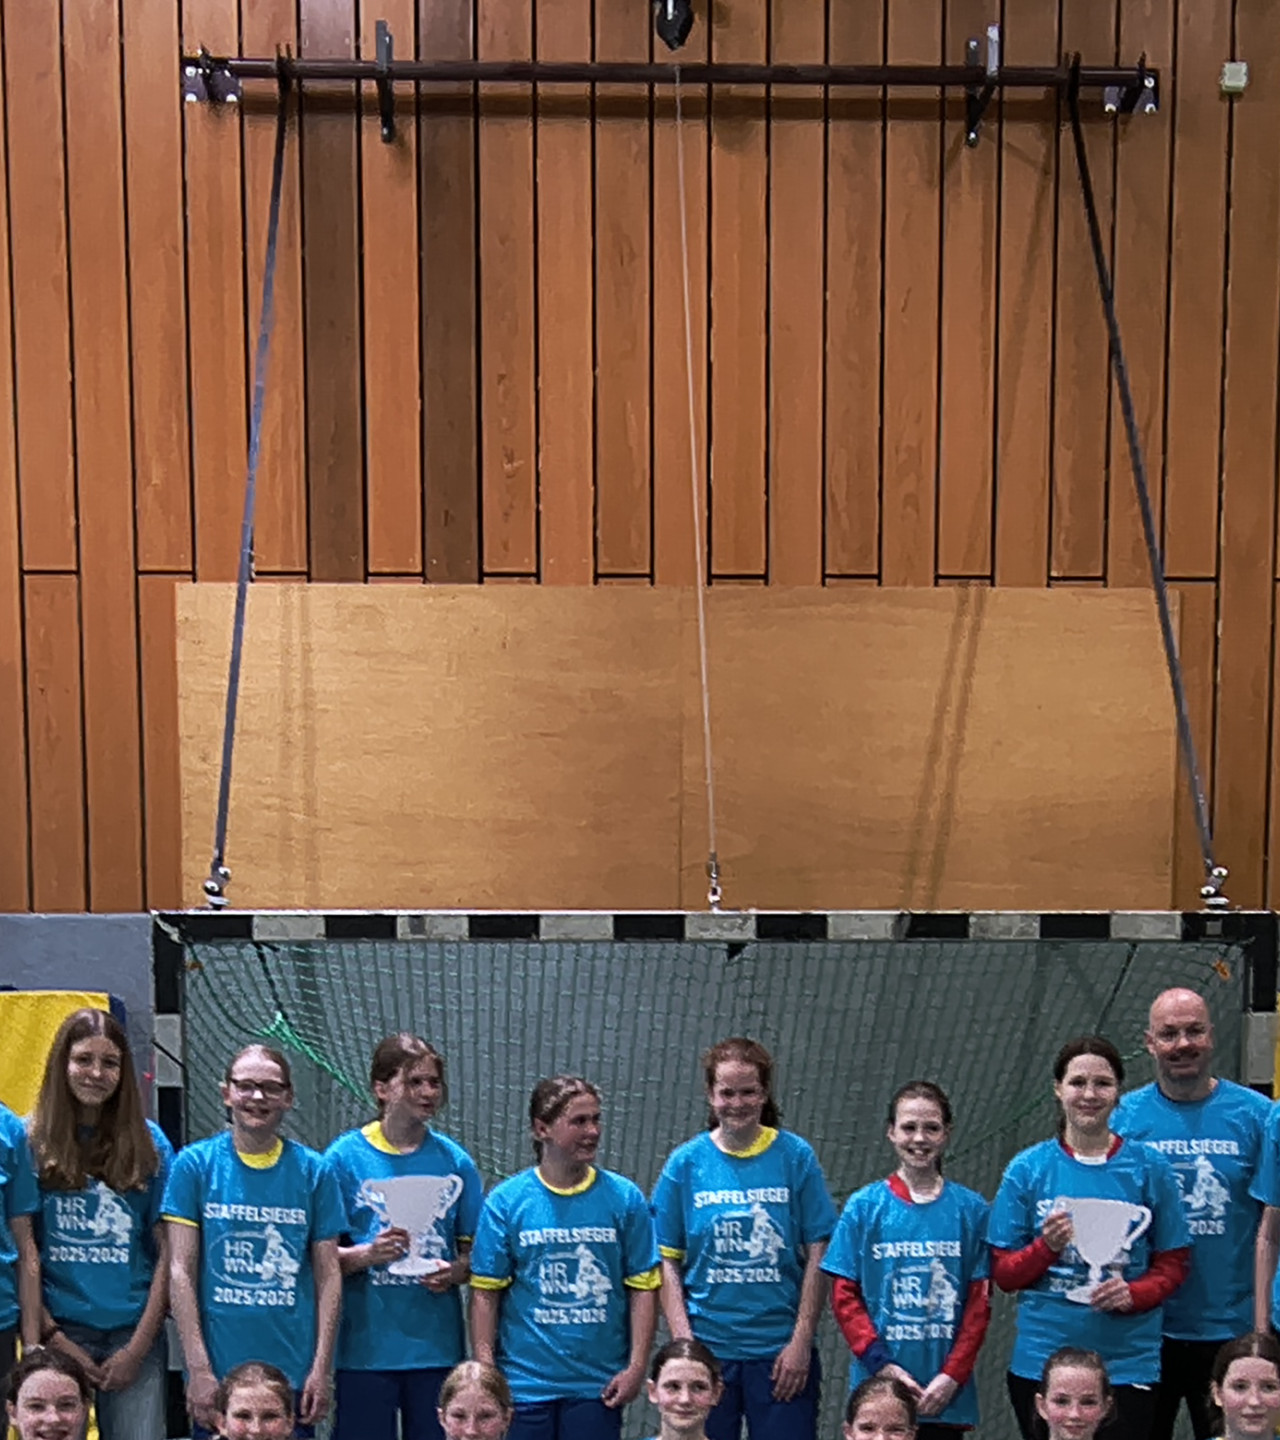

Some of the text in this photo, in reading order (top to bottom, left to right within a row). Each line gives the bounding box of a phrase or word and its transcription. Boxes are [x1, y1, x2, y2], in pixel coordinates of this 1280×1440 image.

[56, 1196, 87, 1214] HR
[203, 1202, 307, 1225] STAFFELSIEGER
[56, 1213, 87, 1231] WN
[713, 1220, 743, 1238] HR
[519, 1226, 617, 1248] STAFFELSIEGER
[713, 1237, 744, 1254] WN
[48, 1246, 130, 1264] 2025/2026
[224, 1240, 254, 1258] HR
[223, 1257, 256, 1274] WN
[539, 1262, 568, 1279] HR
[539, 1279, 569, 1295] WN
[892, 1276, 922, 1293] HR
[213, 1286, 296, 1306] 2025/2026
[892, 1292, 922, 1309] WN
